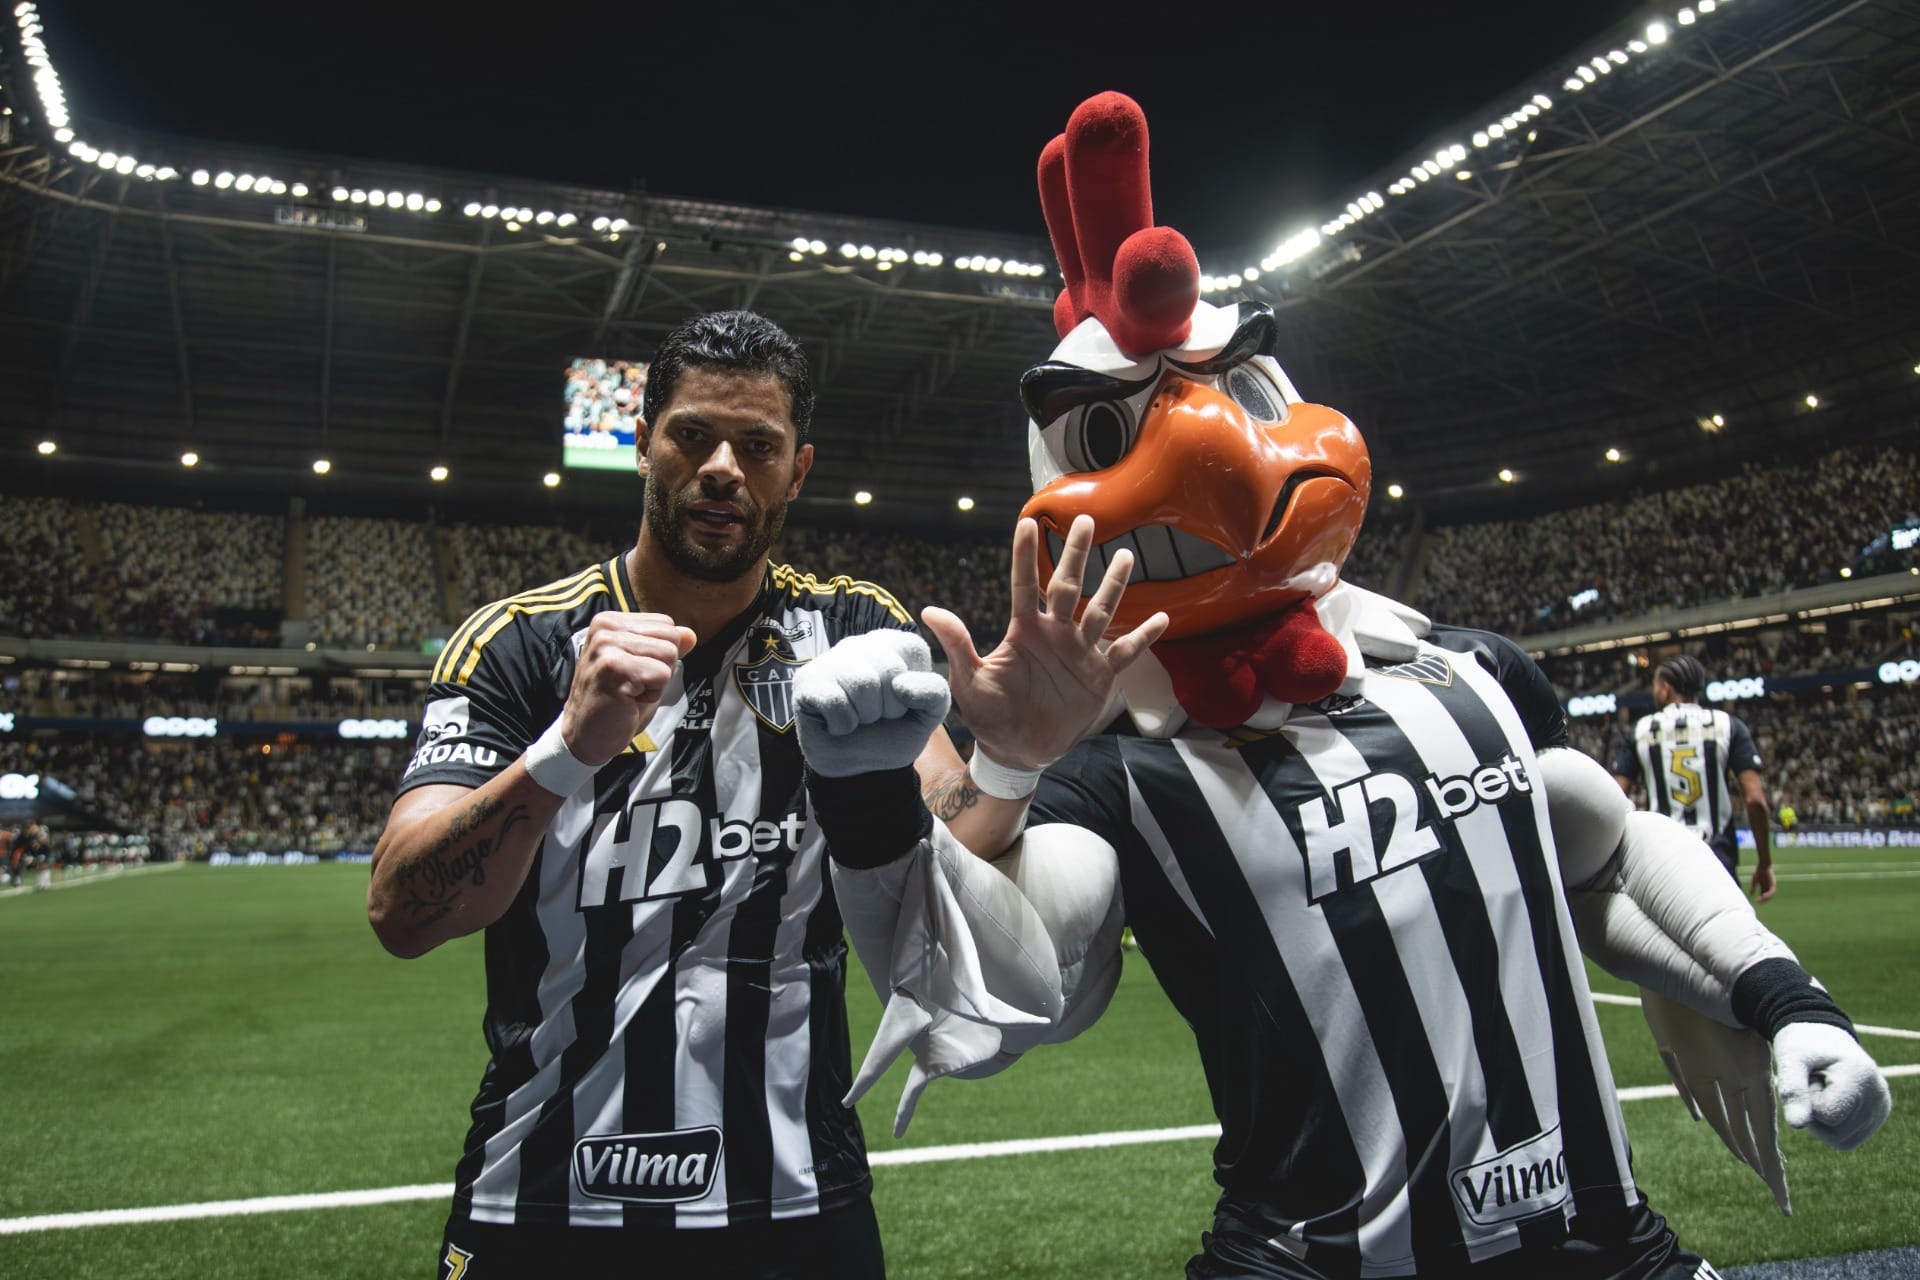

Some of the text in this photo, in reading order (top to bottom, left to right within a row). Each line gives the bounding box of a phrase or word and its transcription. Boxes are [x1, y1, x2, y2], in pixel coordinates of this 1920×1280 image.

[403, 743, 498, 778] ERDAU
[1670, 748, 1703, 807] 5
[582, 1144, 708, 1186] Vilma
